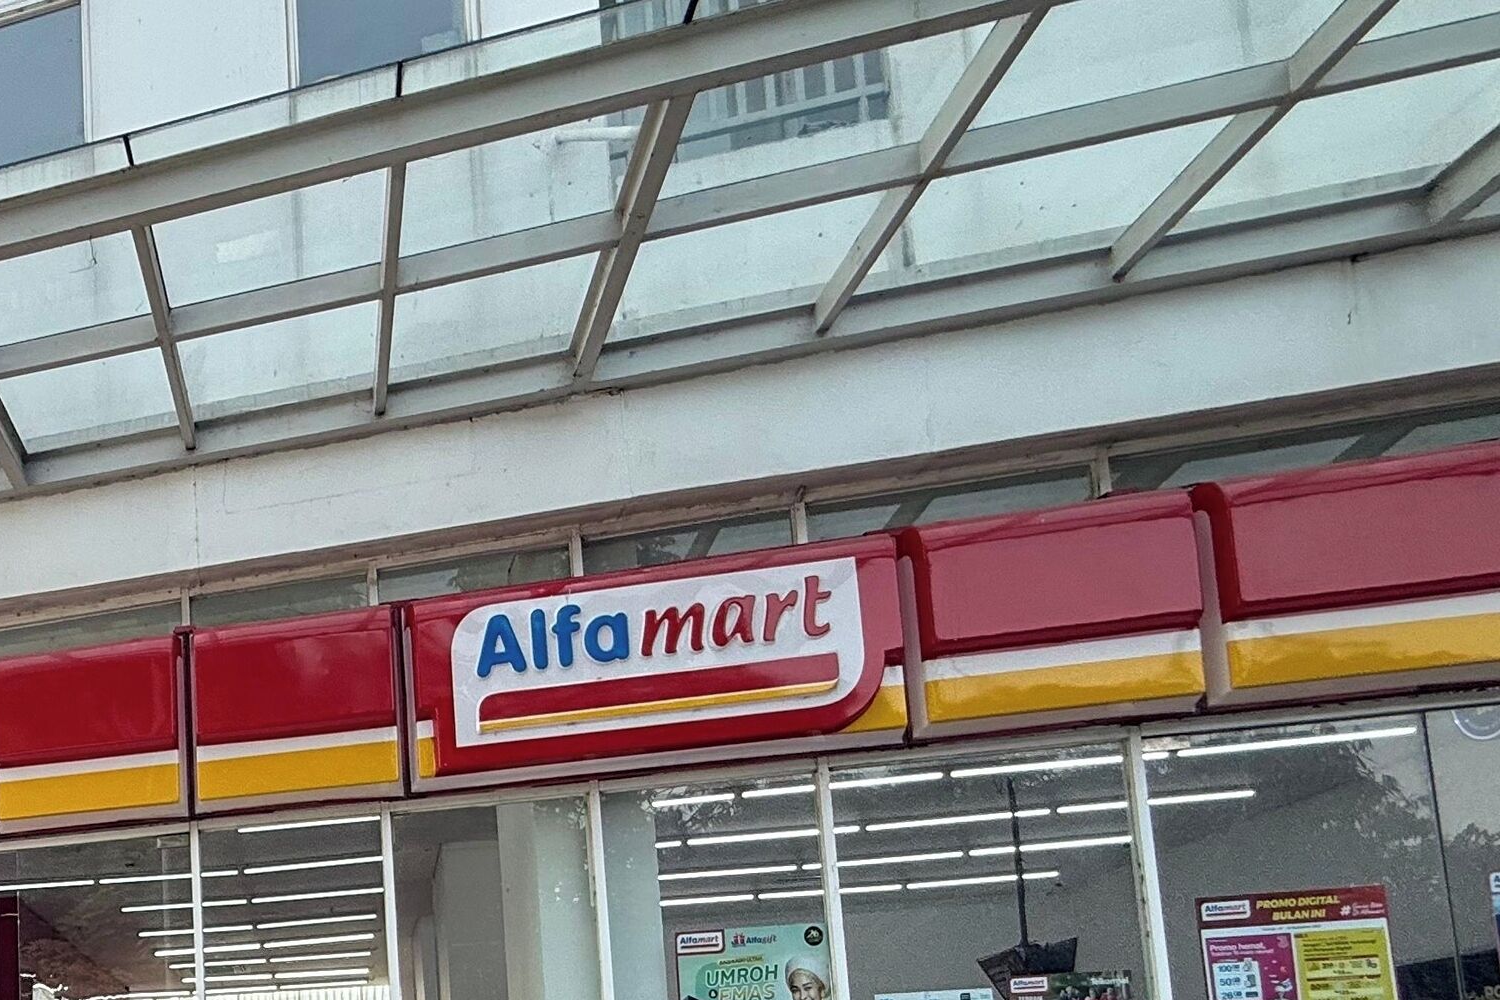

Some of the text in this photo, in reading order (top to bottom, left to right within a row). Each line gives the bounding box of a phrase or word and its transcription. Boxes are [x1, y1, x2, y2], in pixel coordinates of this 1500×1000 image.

[477, 575, 832, 679] Alfamart
[1204, 902, 1247, 913] Alfamart
[1256, 894, 1341, 910] PROMO DIGITAL
[1272, 909, 1326, 921] BULAN INI
[679, 935, 719, 945] Alfamart
[706, 964, 779, 988] UMROH
